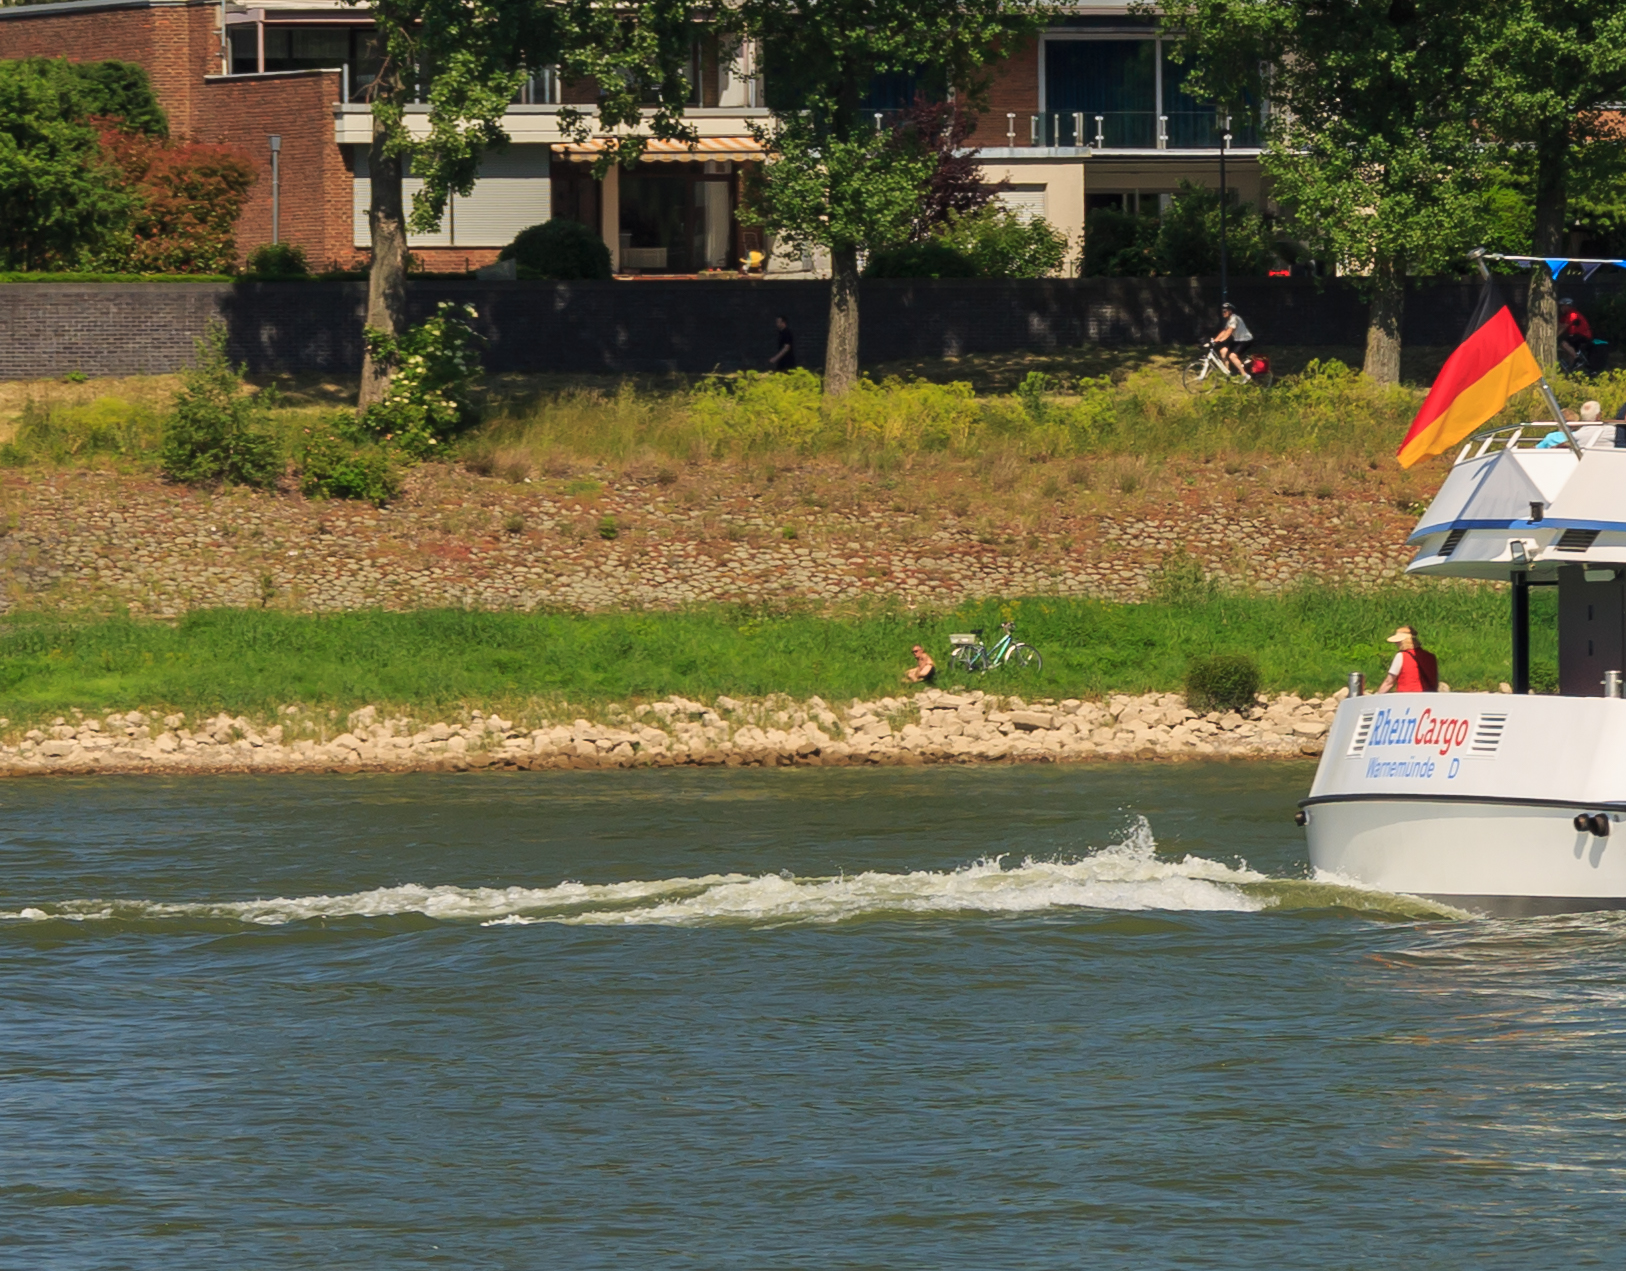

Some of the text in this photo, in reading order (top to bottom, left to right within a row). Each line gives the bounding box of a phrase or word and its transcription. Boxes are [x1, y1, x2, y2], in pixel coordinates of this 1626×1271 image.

[1368, 707, 1469, 756] RheinCargo
[1366, 756, 1460, 779] Warnemünde D
